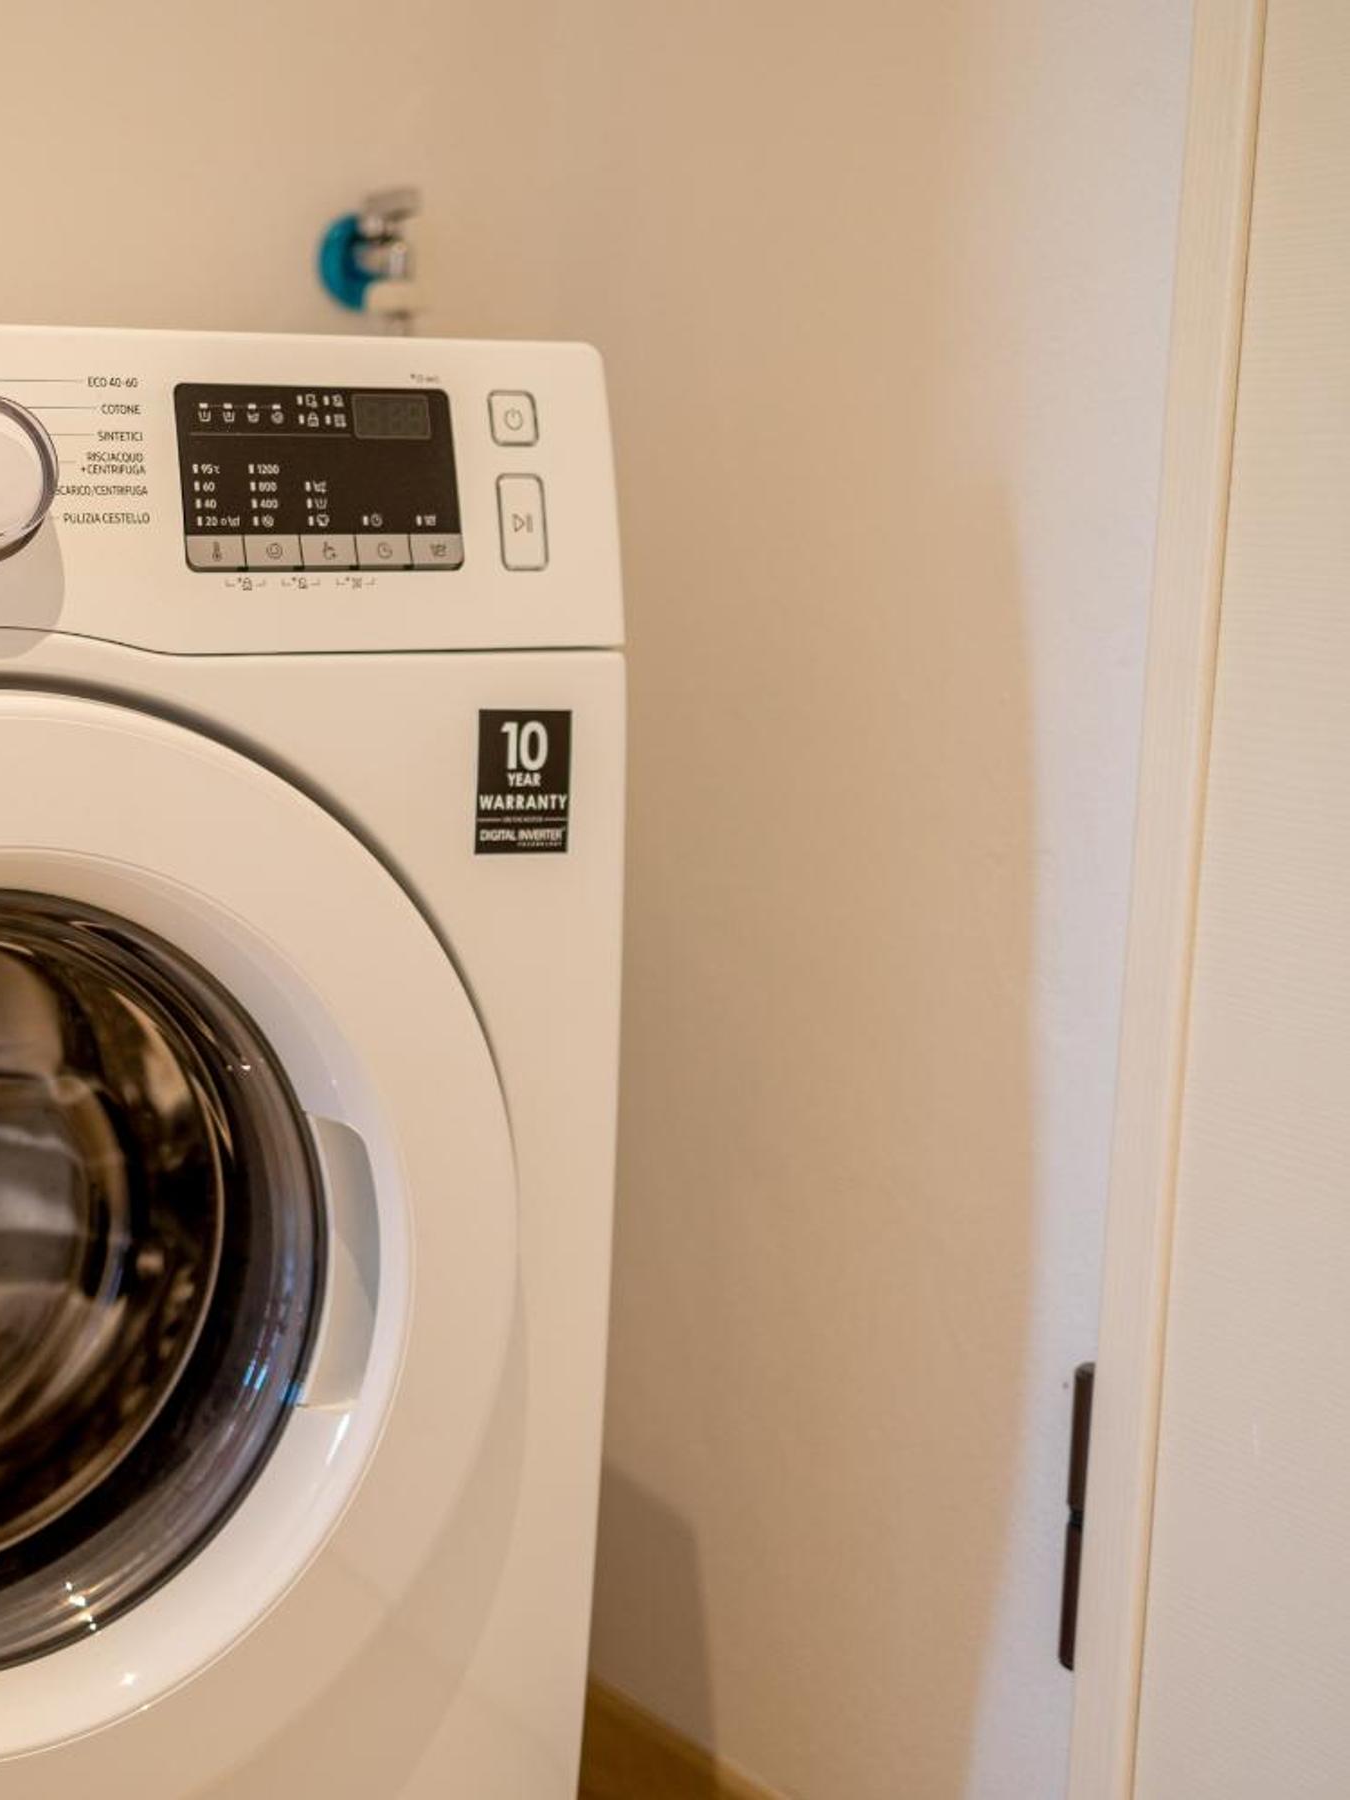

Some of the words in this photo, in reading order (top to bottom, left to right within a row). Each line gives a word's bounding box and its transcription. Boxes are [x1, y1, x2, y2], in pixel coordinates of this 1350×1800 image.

[87, 376, 107, 388] ECO
[100, 404, 141, 415] COTONE
[97, 431, 143, 442] SINTETICI
[256, 464, 280, 475] 1200
[202, 481, 215, 492] 60
[203, 499, 217, 509] 40
[260, 498, 278, 509] 400
[102, 512, 150, 524] CESTELLO
[205, 516, 218, 526] 20
[500, 720, 549, 771] 10
[506, 772, 542, 787] YEAR
[479, 794, 568, 811] WARRANTY
[479, 829, 516, 842] DIGITAL
